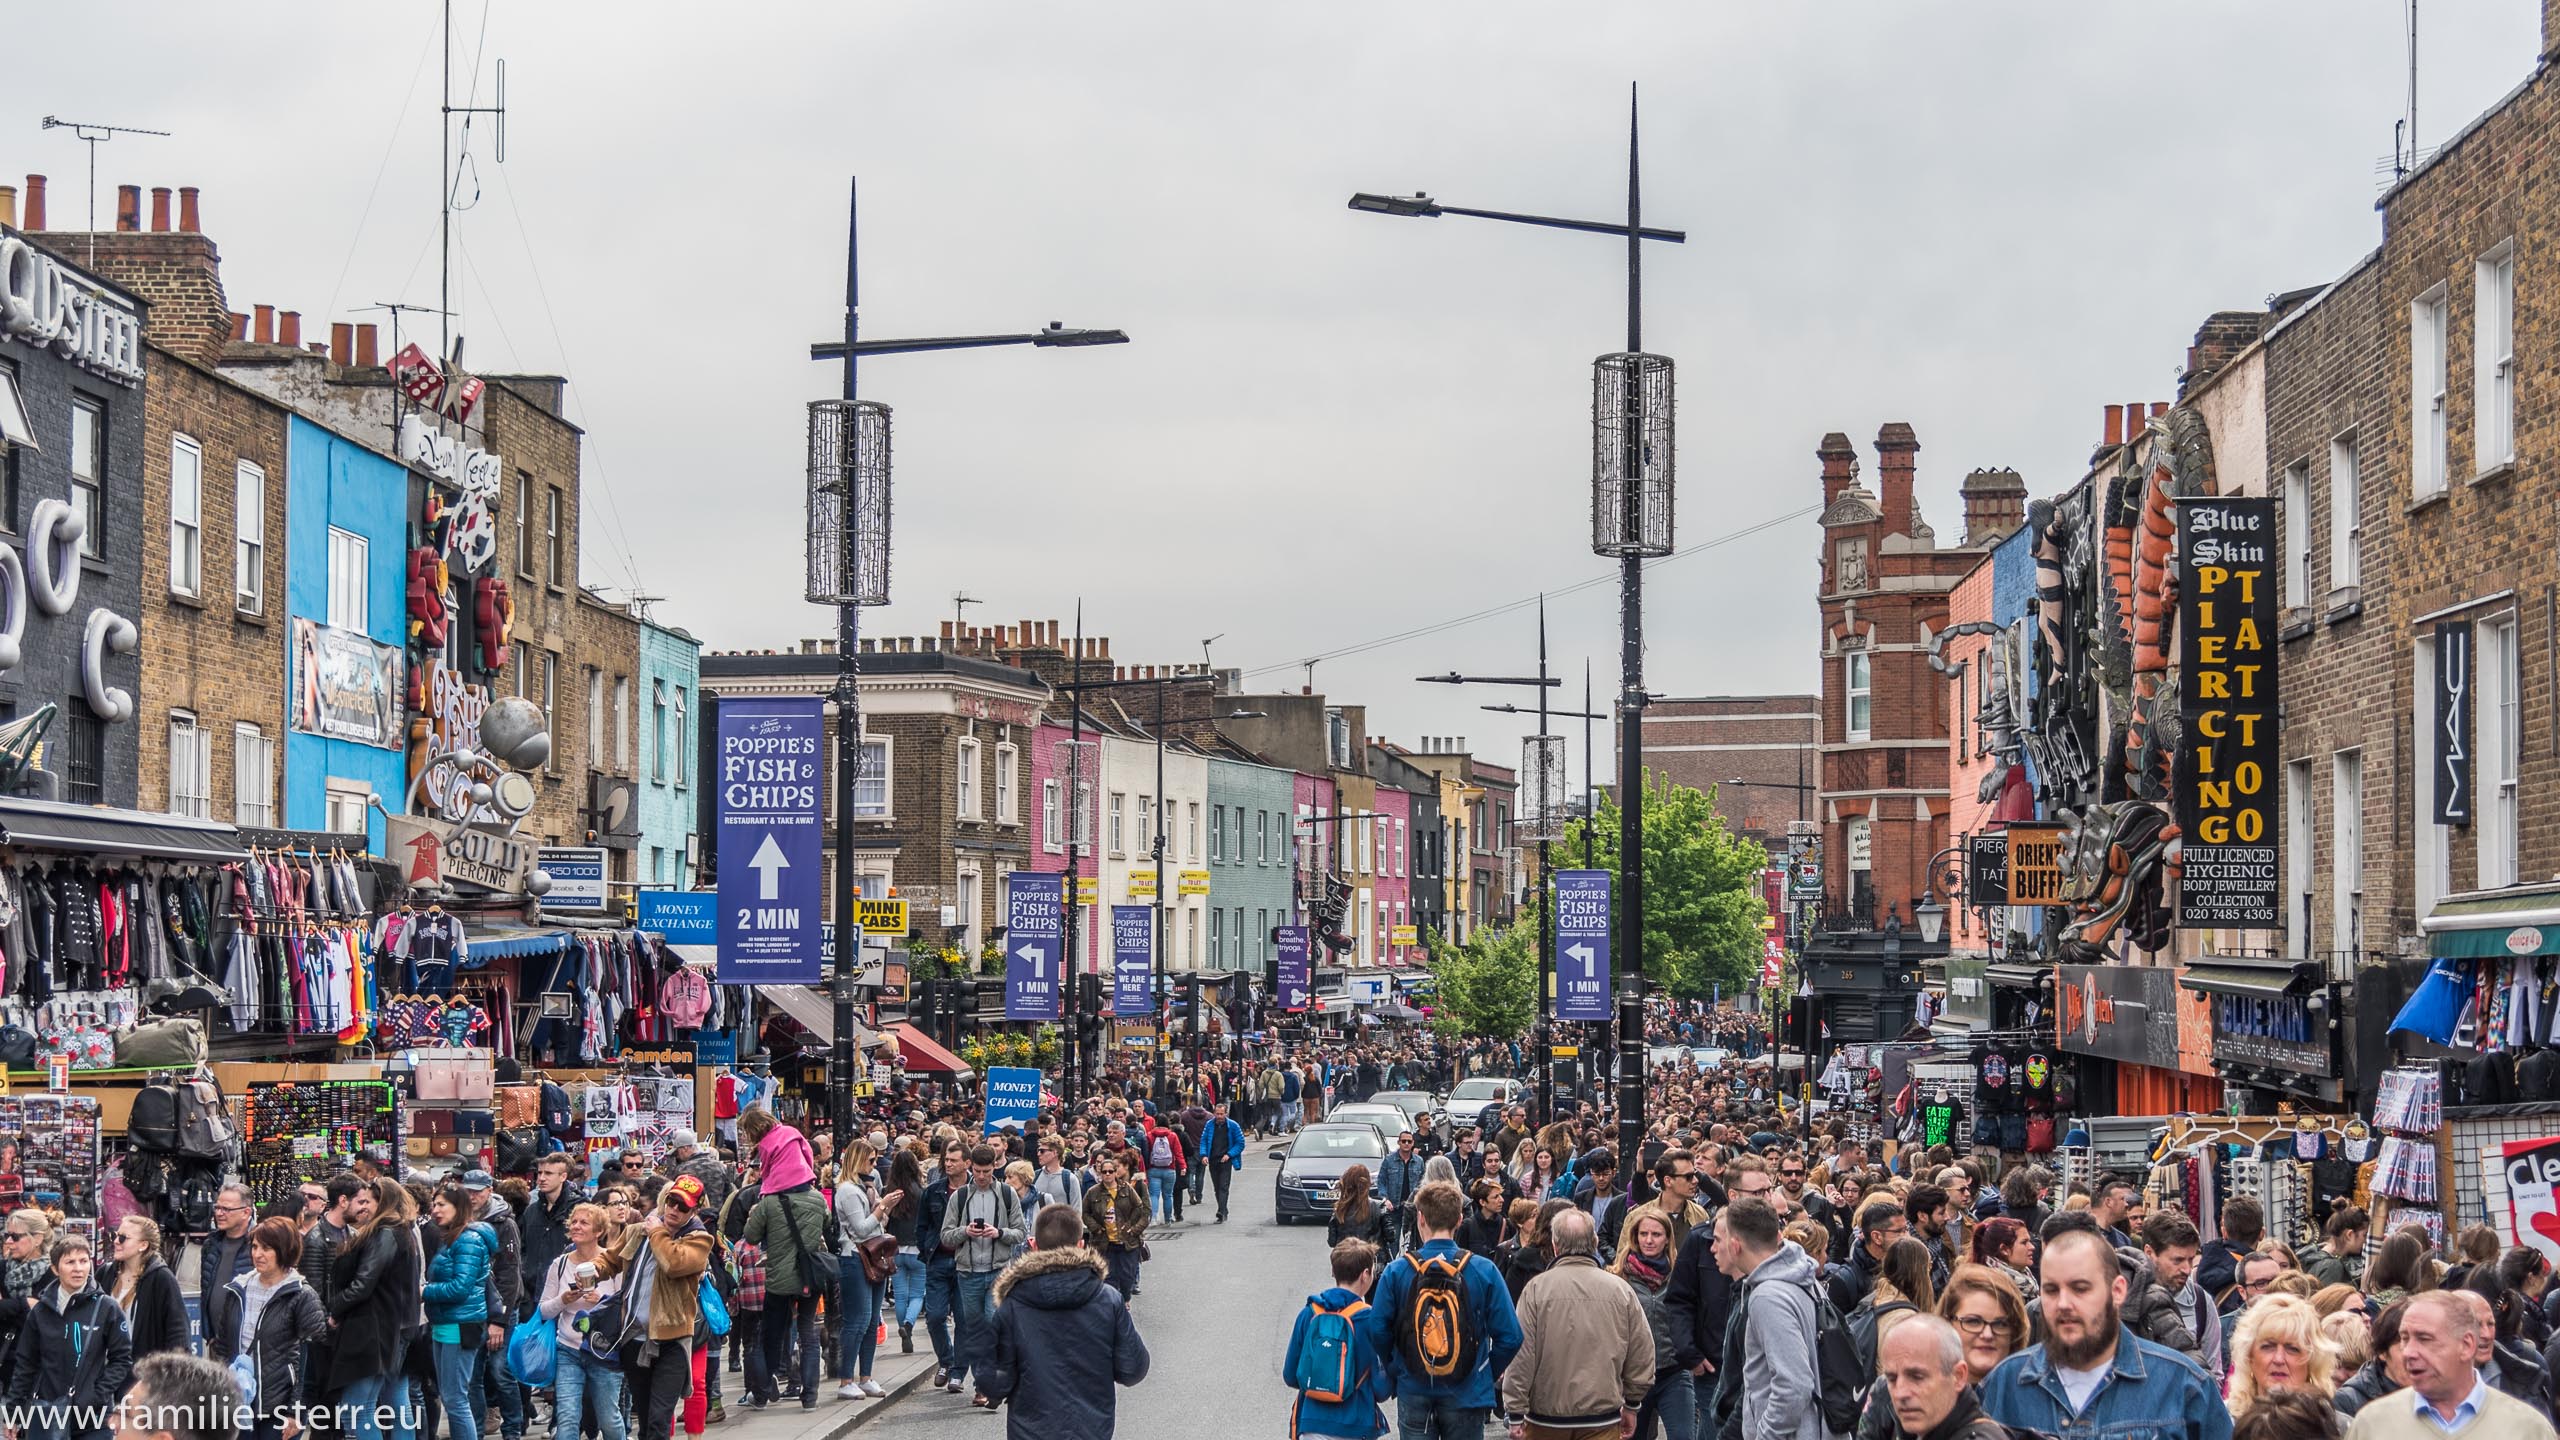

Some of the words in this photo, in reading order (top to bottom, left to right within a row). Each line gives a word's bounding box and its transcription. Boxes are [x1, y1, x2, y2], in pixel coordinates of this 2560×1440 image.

[0, 237, 64, 342] OLD
[2189, 507, 2260, 533] Blue
[2190, 538, 2264, 567] Skin
[2196, 566, 2233, 844] PIERCING
[2233, 570, 2264, 842] TATTOO
[725, 736, 815, 754] POPPIE'S
[725, 756, 797, 782] FISH
[801, 764, 815, 779] &
[725, 783, 815, 808] CHIPS
[724, 817, 770, 825] RESTAURANT
[770, 817, 776, 825] &
[777, 817, 794, 825] TAKE
[795, 817, 815, 825] AWAY
[420, 837, 435, 850] UP
[2016, 843, 2066, 867] ORIENT
[2183, 848, 2216, 862] FULLY
[2218, 848, 2275, 863] LICENCED
[449, 858, 507, 889] PIERCING
[572, 867, 599, 876] 1000
[2184, 865, 2274, 878] HYGIENIC
[2183, 880, 2213, 891] BODY
[2213, 880, 2276, 894] JEWELLERY
[1012, 891, 1059, 901] POPPIE'S
[1559, 889, 1607, 900] POPPIE'S
[2196, 895, 2266, 907] COLLECTION
[655, 904, 702, 915] MONEY
[860, 902, 901, 914] MINI
[1012, 902, 1049, 916] FISH
[1050, 906, 1058, 914] &
[1559, 900, 1597, 915] FISH
[1599, 905, 1607, 913] &
[2185, 908, 2209, 920] 020
[2212, 908, 2240, 920] 7485
[2243, 908, 2274, 920] 4305
[641, 918, 714, 930] EXCHANGE
[737, 908, 751, 930] 2
[757, 908, 799, 930] MIN
[859, 915, 901, 928] CABS
[1011, 916, 1058, 930] CHIPS
[1115, 919, 1149, 927] POPPIE'S
[1559, 915, 1607, 929] CHIPS
[1116, 927, 1142, 937] FISH
[1279, 928, 1296, 937] stop.
[1116, 937, 1149, 948] CHIPS
[1279, 936, 1306, 944] breathe.
[1279, 944, 1303, 952] triyoga.
[1118, 975, 1130, 984] WE
[1131, 975, 1146, 984] ARE
[1017, 981, 1023, 993] 1
[1026, 981, 1049, 994] MIN
[1122, 984, 1142, 992] HERE
[1567, 981, 1573, 993] 1
[1577, 981, 1600, 993] MIN
[621, 1047, 693, 1063] Camden
[993, 1081, 1035, 1093] MONEY
[989, 1097, 1037, 1109] CHANGE
